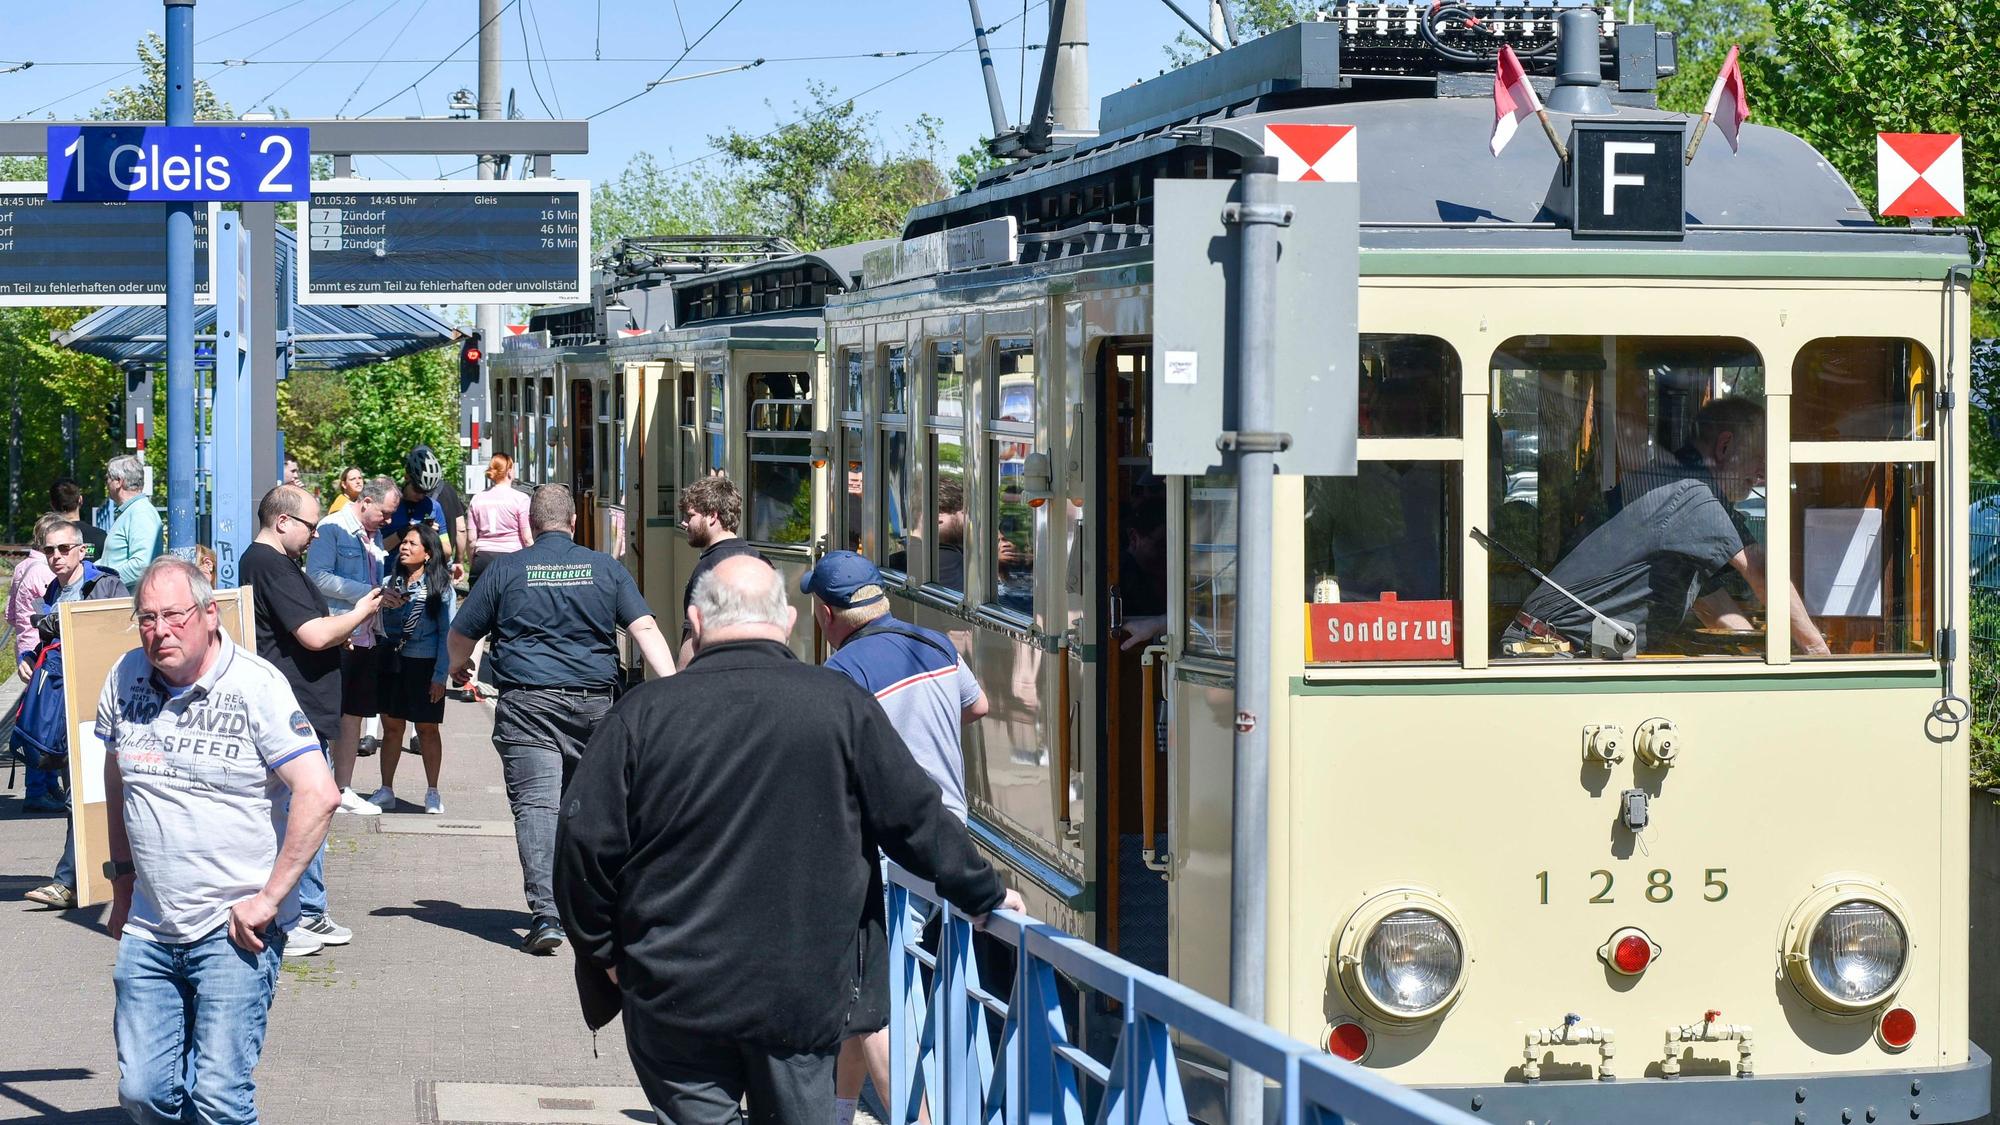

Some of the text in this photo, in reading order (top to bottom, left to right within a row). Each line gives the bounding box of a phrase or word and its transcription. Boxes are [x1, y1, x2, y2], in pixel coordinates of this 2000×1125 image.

[64, 135, 293, 193] 1 Gleis 2
[1603, 141, 1656, 216] F
[26, 197, 45, 206] Uhr
[314, 196, 560, 205] 01.05.26 14:45 Uhr Gleis in
[323, 210, 578, 221] 7 Zündorf 16 Min
[323, 224, 578, 235] 7 Zündorf 46 Min
[323, 238, 578, 249] 7 Zündorf 76 Min
[13, 283, 32, 293] Teil
[49, 282, 116, 293] fehlerhaften
[118, 282, 145, 293] oder
[383, 281, 402, 291] Teil
[420, 280, 485, 291] fehlerhaften
[488, 280, 513, 290] oder
[515, 280, 577, 290] unvollständ
[525, 563, 592, 571] Straßenbahn-Museum
[527, 569, 593, 579] THIELENBRUCH
[1328, 617, 1452, 646] Sonderzug
[176, 706, 247, 736] DAVID
[163, 735, 240, 760] SPEED
[1535, 868, 1730, 905] 1285
